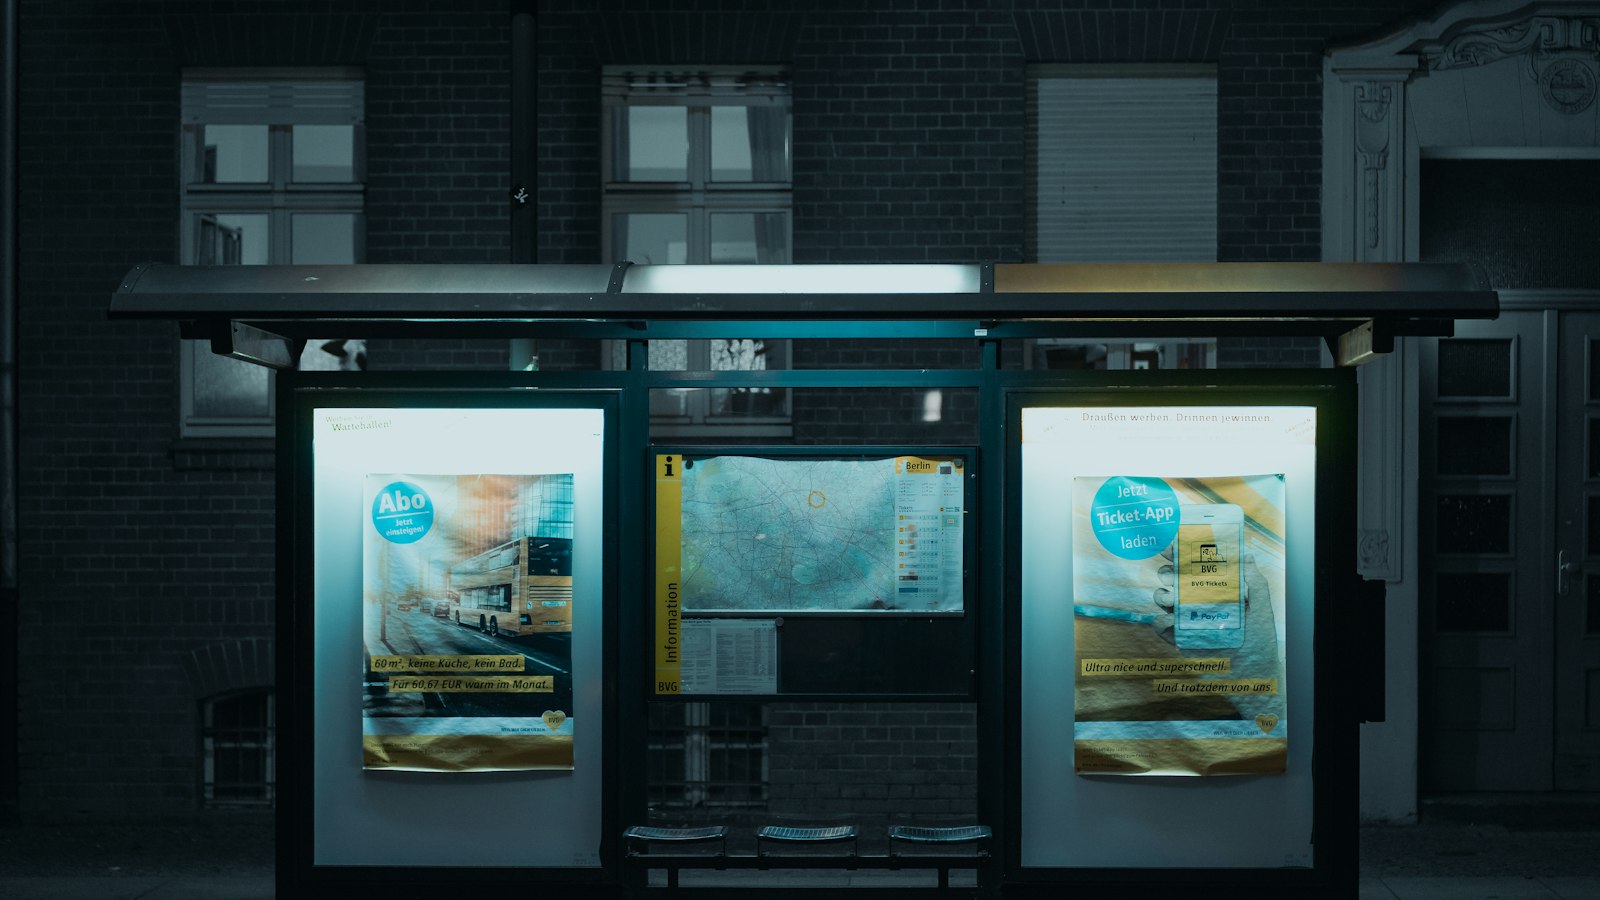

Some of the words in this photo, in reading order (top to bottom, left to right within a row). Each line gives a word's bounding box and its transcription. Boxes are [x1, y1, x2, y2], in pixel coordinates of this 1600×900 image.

[1176, 413, 1218, 422] Drinnen
[906, 461, 931, 470] Berlin
[1117, 484, 1149, 499] Jetzt
[378, 490, 426, 514] Abo
[1096, 506, 1174, 526] Ticket-App
[385, 525, 424, 537] einsteigen!
[1120, 534, 1157, 550] laden
[1201, 565, 1218, 573] BVG
[1201, 612, 1230, 621] PayPal
[664, 582, 678, 663] Information
[374, 659, 387, 668] 60
[408, 658, 435, 668] keine
[474, 658, 496, 668] kein
[499, 658, 521, 668] Bad.
[1085, 662, 1111, 672] Ultra
[1113, 662, 1134, 672] nice
[1137, 662, 1157, 672] und
[1159, 661, 1227, 674] superschnell.
[392, 679, 411, 689] Für
[412, 679, 439, 690] 60,67
[442, 679, 462, 689] EUR
[496, 679, 510, 689] im
[512, 679, 549, 689] Monat.
[658, 681, 677, 692] BVG
[1157, 683, 1178, 693] Und
[1181, 683, 1228, 692] trotzdem
[1231, 684, 1250, 692] von
[1252, 684, 1273, 692] uns.
